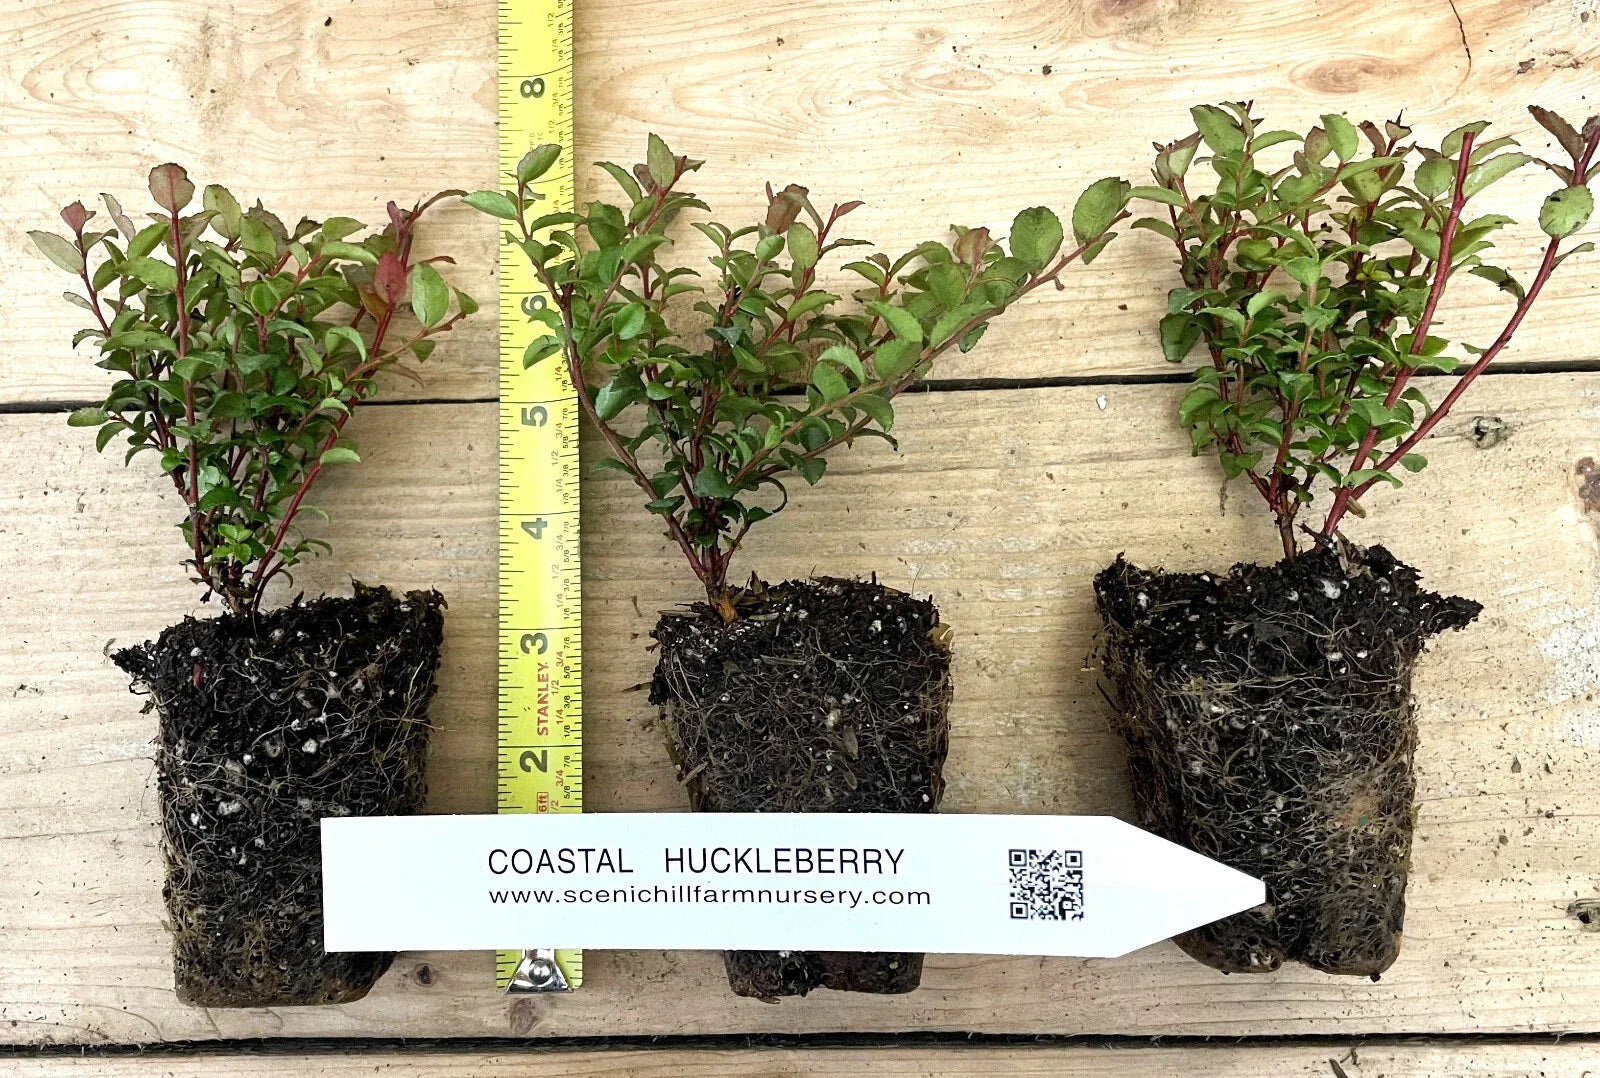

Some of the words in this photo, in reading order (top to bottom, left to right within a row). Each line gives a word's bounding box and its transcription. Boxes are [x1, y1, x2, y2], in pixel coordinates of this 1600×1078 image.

[547, 12, 555, 28] 1/2
[520, 77, 545, 98] 8
[521, 294, 547, 317] 6
[521, 405, 548, 427] 5
[550, 450, 559, 466] 1/2
[555, 478, 563, 493] 1/4
[521, 517, 548, 540] 4
[555, 534, 564, 551] 3/4
[551, 563, 560, 580] 1/2
[556, 593, 564, 608] 1/4
[563, 607, 571, 620] 1/8
[520, 632, 548, 655] 3
[563, 636, 571, 649] 7/8
[556, 650, 564, 667] 3/4
[563, 665, 571, 679] 5/8
[551, 679, 560, 696] 1/2
[537, 662, 549, 736] STANLEY
[563, 694, 571, 709] 3/8
[556, 708, 564, 725] 1/4
[563, 724, 571, 738] 1/8
[519, 749, 548, 773] 2
[563, 755, 571, 768] 7/8
[556, 769, 564, 787] 3/4
[563, 785, 571, 800] 5/8
[538, 794, 548, 814] 6ft
[488, 848, 634, 874] COASTAL
[665, 847, 905, 874] HUCKLEBERRY
[488, 885, 931, 908] www.scenichillfarmnursery.com
